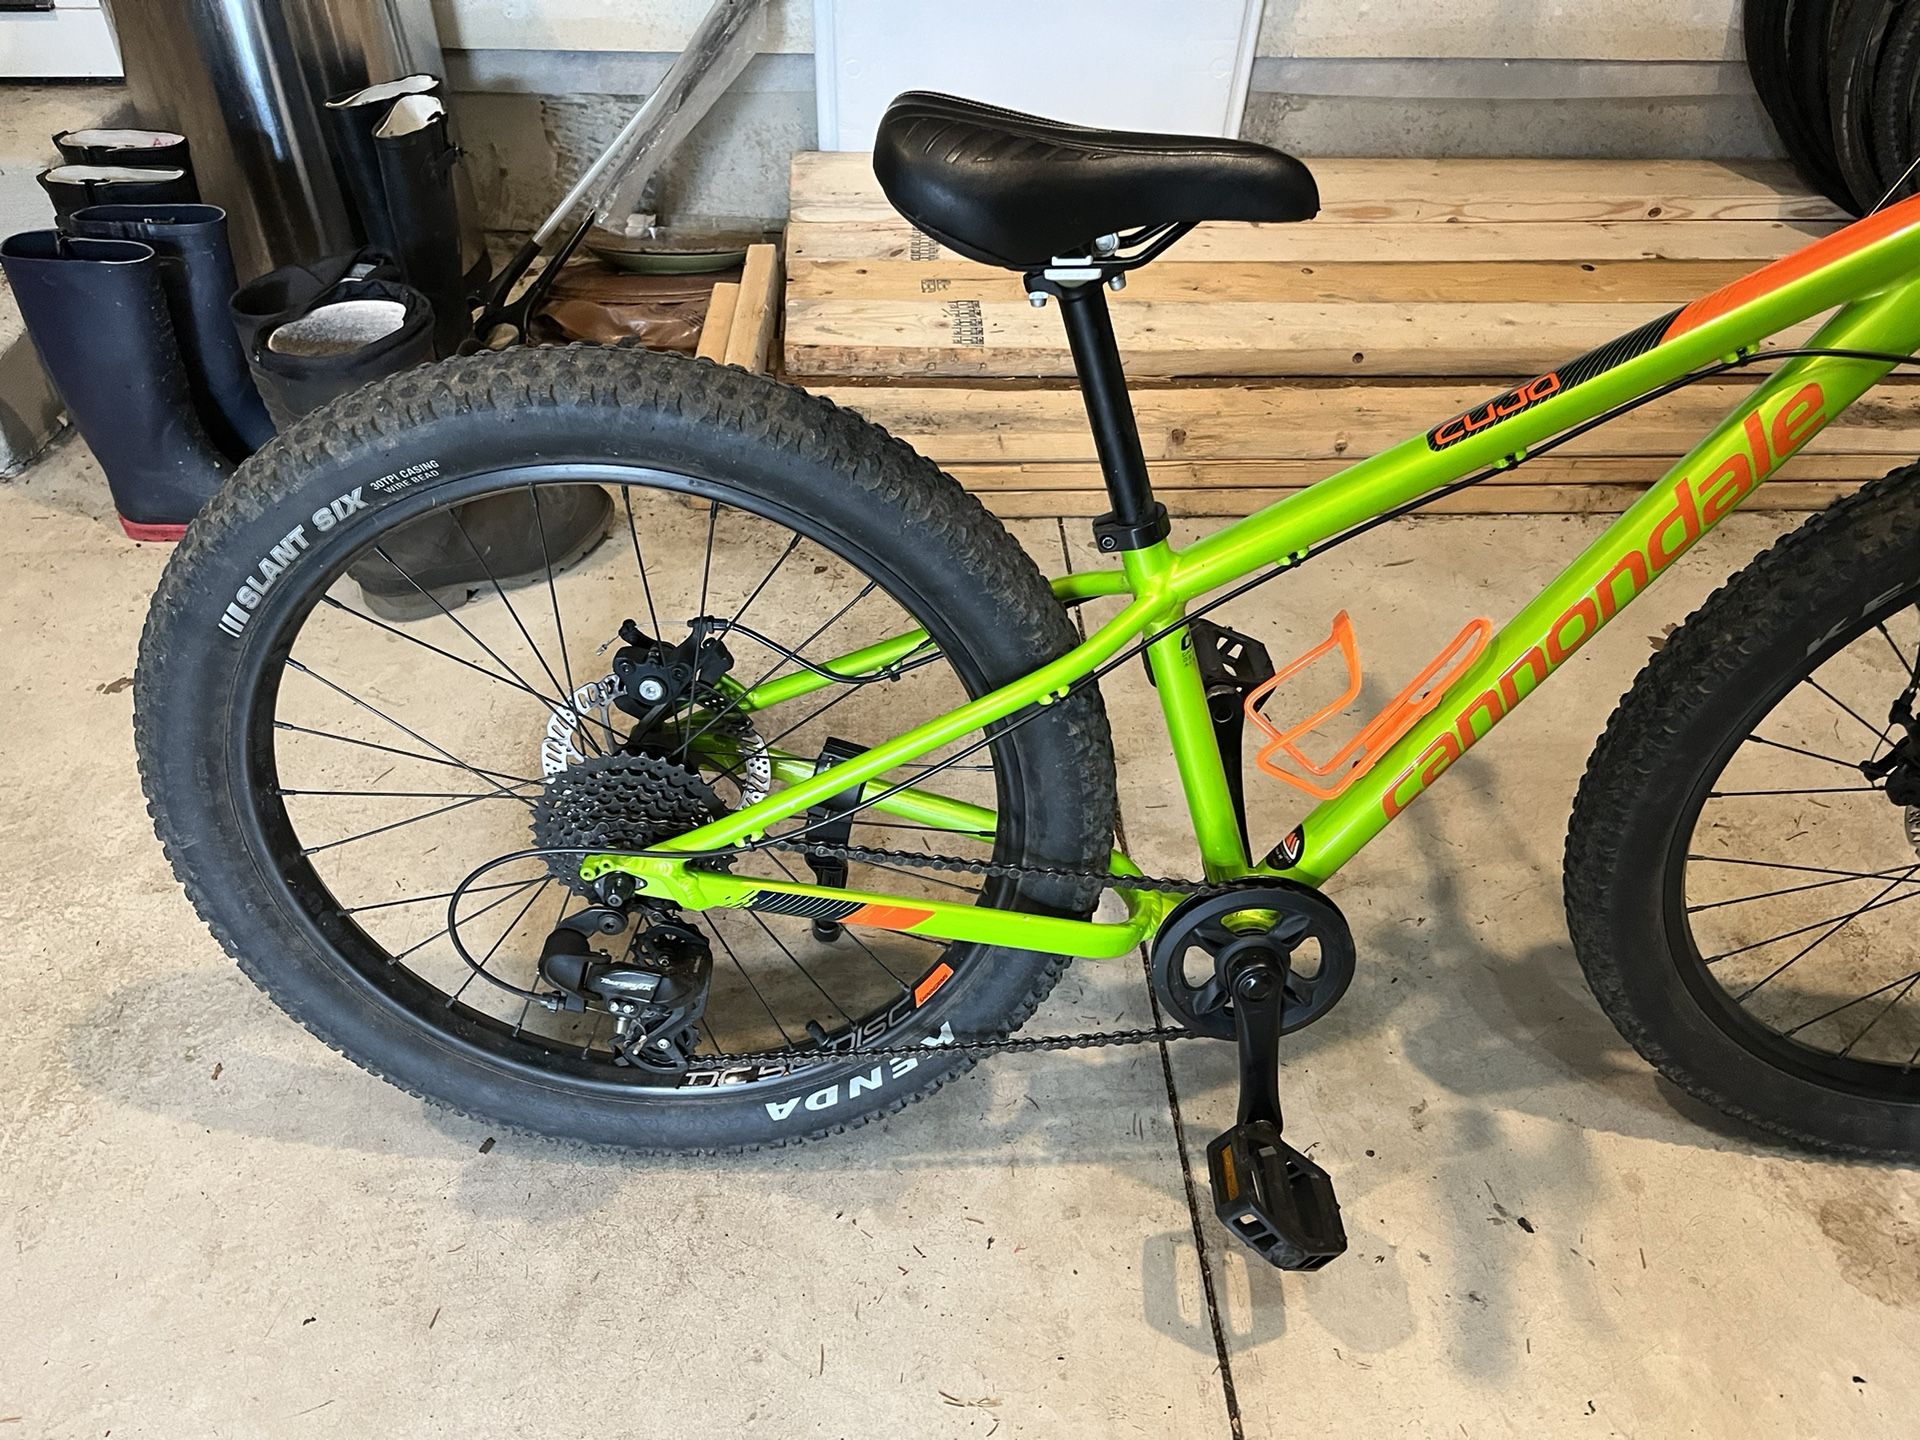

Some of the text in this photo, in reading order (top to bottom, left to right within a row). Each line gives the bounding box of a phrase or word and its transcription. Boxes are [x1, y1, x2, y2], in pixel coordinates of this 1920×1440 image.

[1435, 372, 1560, 445] CUJO
[370, 459, 439, 491] 30TPI CASING
[383, 469, 440, 494] WIRE BEAD
[236, 486, 369, 610] SLANT SIX
[1382, 382, 1826, 822] cannondale
[765, 1021, 956, 1121] KENDA
